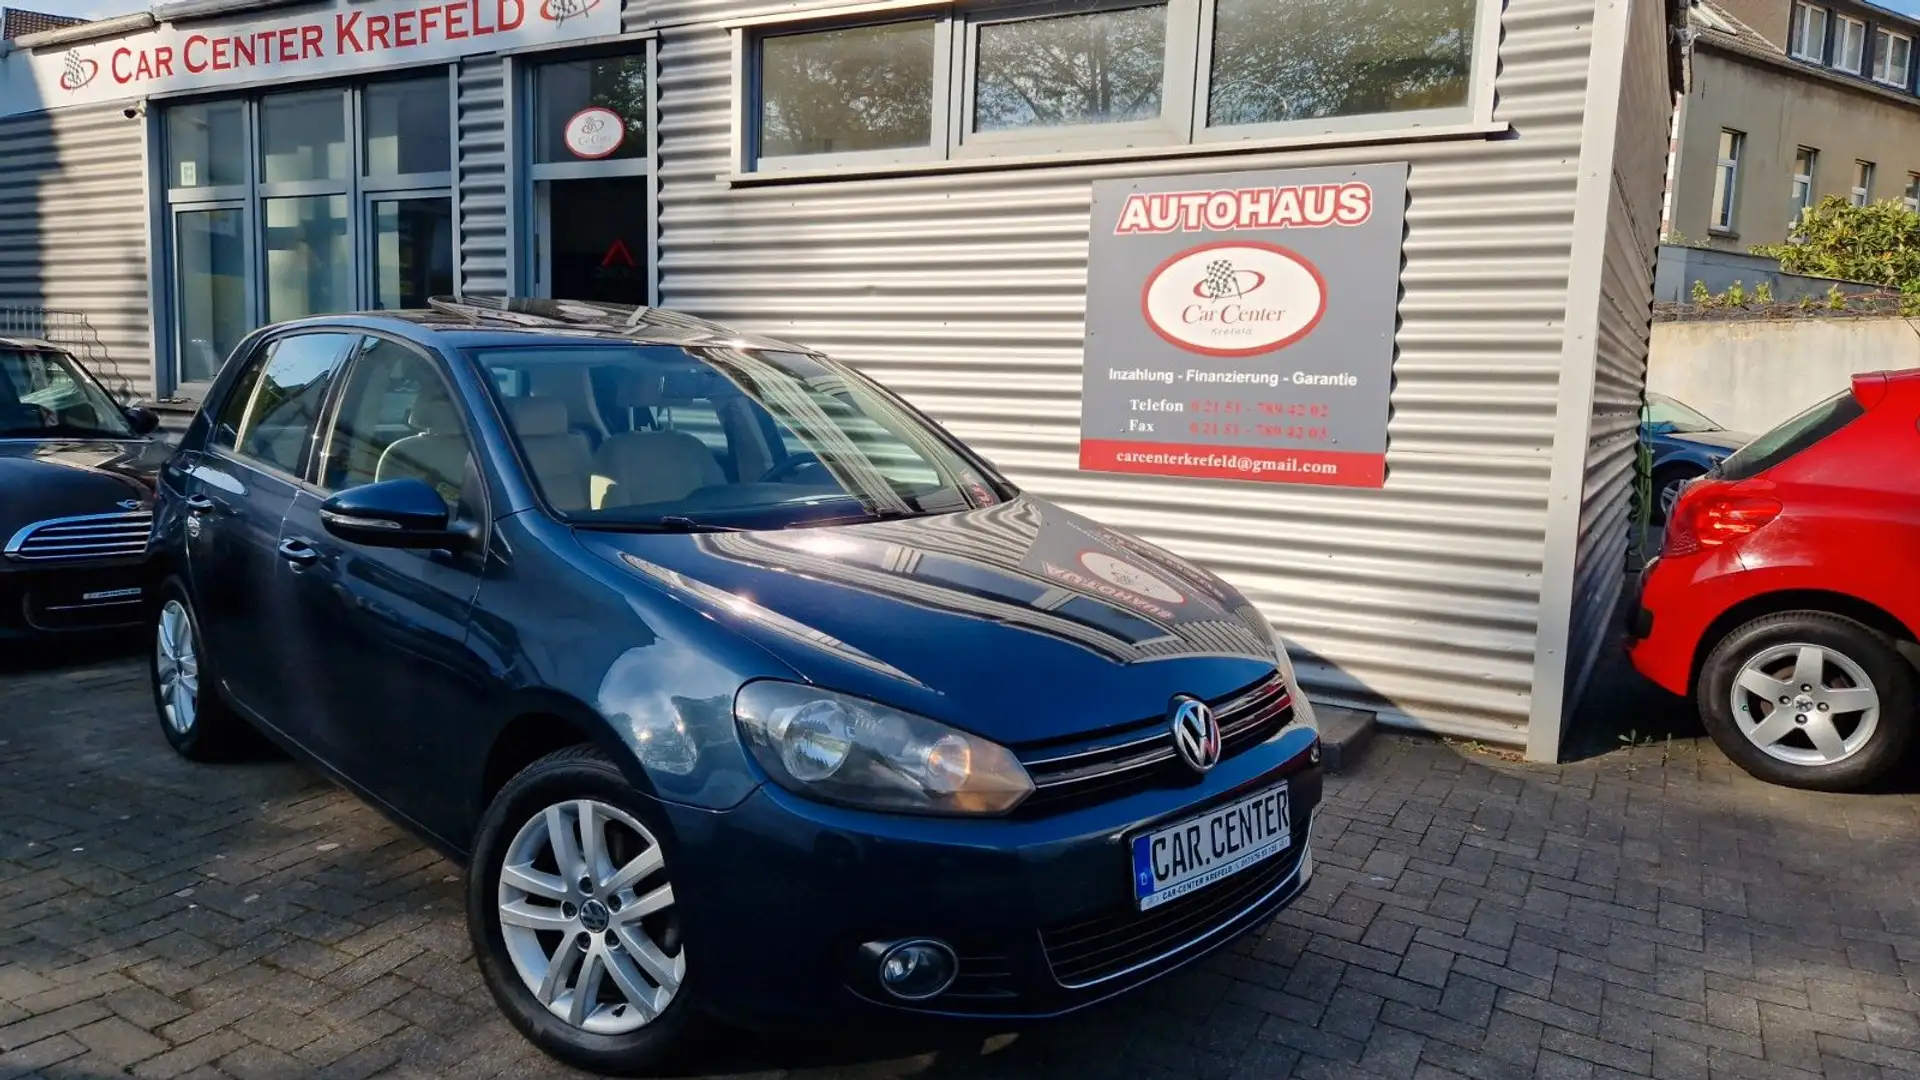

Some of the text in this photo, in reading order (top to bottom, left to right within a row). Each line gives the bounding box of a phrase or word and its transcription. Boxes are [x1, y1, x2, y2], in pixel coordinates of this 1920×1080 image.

[112, 0, 525, 84] CAR CENTER KREFELD
[1114, 182, 1373, 235] AUTOHAUS
[1182, 304, 1286, 324] Car Center
[1109, 368, 1174, 384] Inzahlung
[1187, 370, 1279, 387] Finanzierung
[1292, 372, 1358, 387] Garantie
[1130, 399, 1184, 413] Telefon
[1129, 419, 1154, 432] Fax
[1116, 451, 1337, 474] carcenterkrefeld@gmail.com
